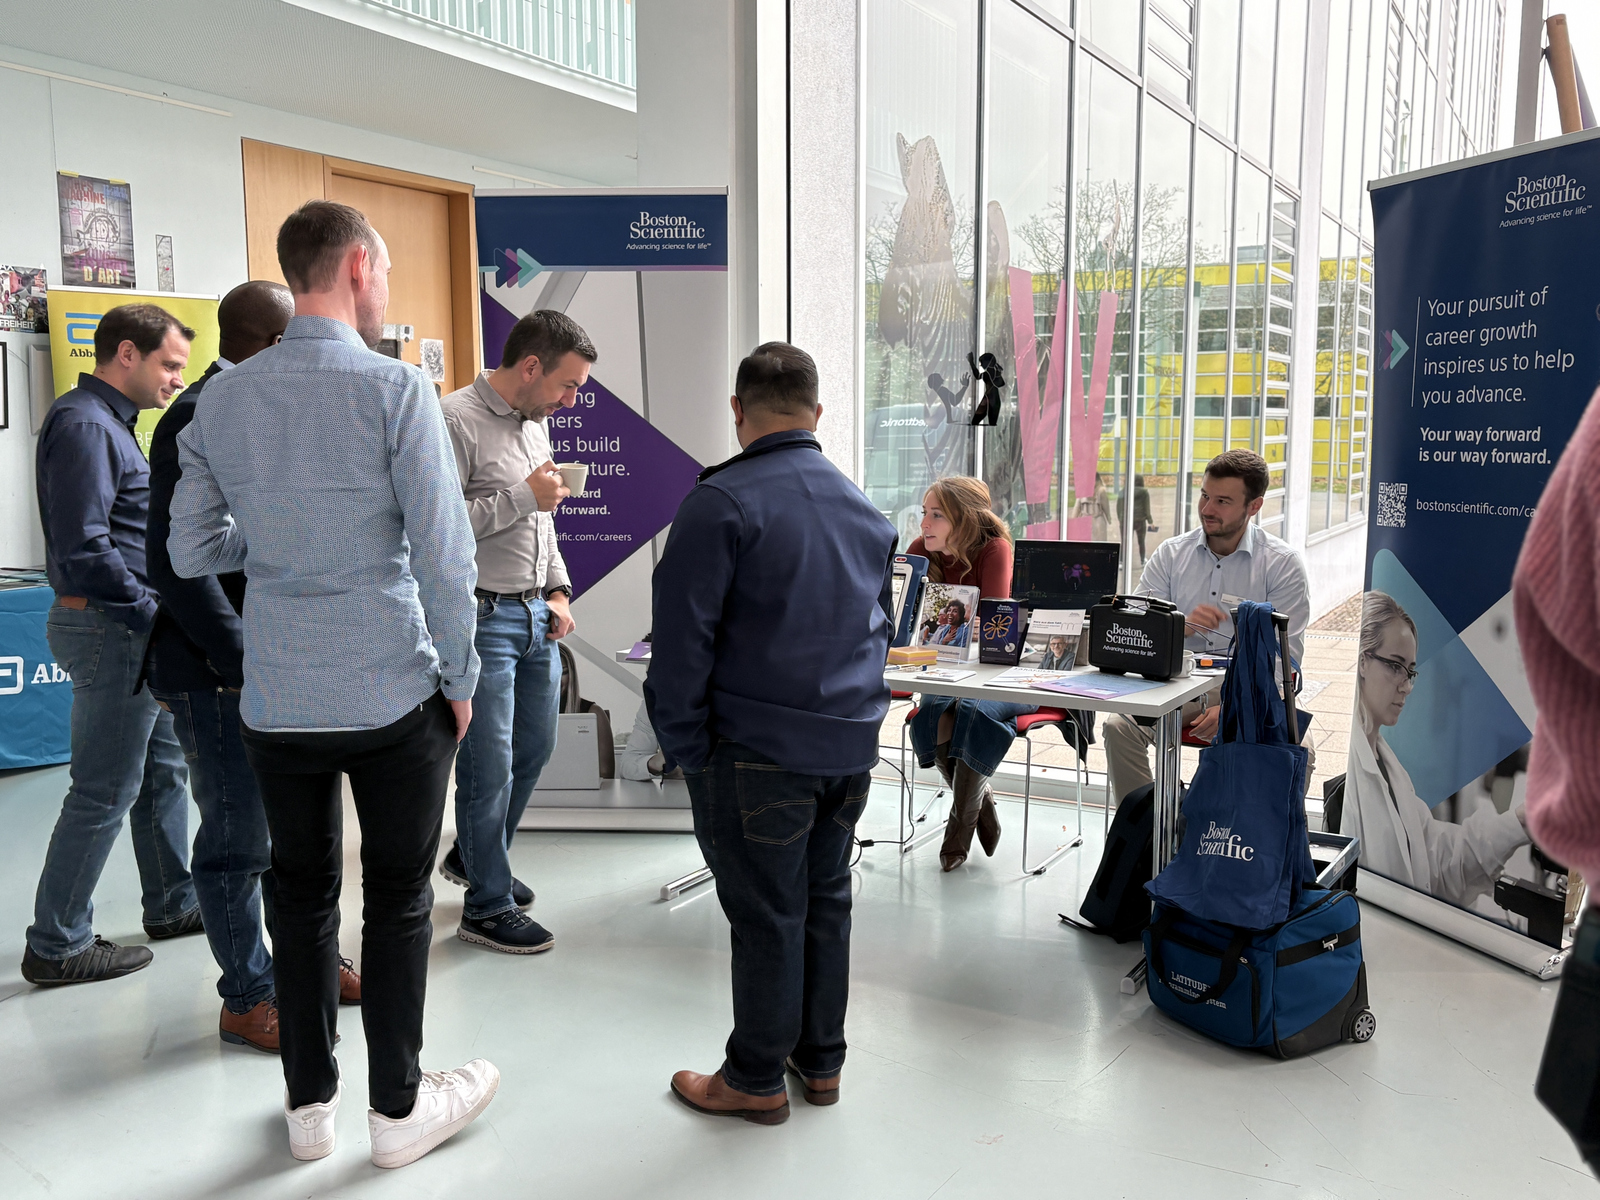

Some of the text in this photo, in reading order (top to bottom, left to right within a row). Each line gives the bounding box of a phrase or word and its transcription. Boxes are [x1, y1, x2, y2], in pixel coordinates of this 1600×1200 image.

[1516, 173, 1567, 196] Boston
[1504, 178, 1586, 214] Scientific
[639, 211, 687, 227] Boston
[1499, 216, 1535, 228] Advancing
[1536, 212, 1561, 221] science
[1562, 208, 1573, 217] for
[629, 220, 705, 239] Scientific
[625, 243, 660, 252] Advancing
[686, 242, 696, 250] for
[1427, 286, 1549, 318] Your pursuit of
[1425, 319, 1537, 347] career growth
[1423, 348, 1575, 379] inspires us to help
[1421, 385, 1527, 408] you advance.
[551, 436, 620, 453] us build
[1420, 426, 1541, 445] Your way forward
[1418, 447, 1552, 466] is our way forward.
[561, 504, 611, 515] forward.
[1105, 629, 1154, 649] Scientific
[1112, 622, 1142, 637] Boston
[1102, 644, 1124, 654] Advancing
